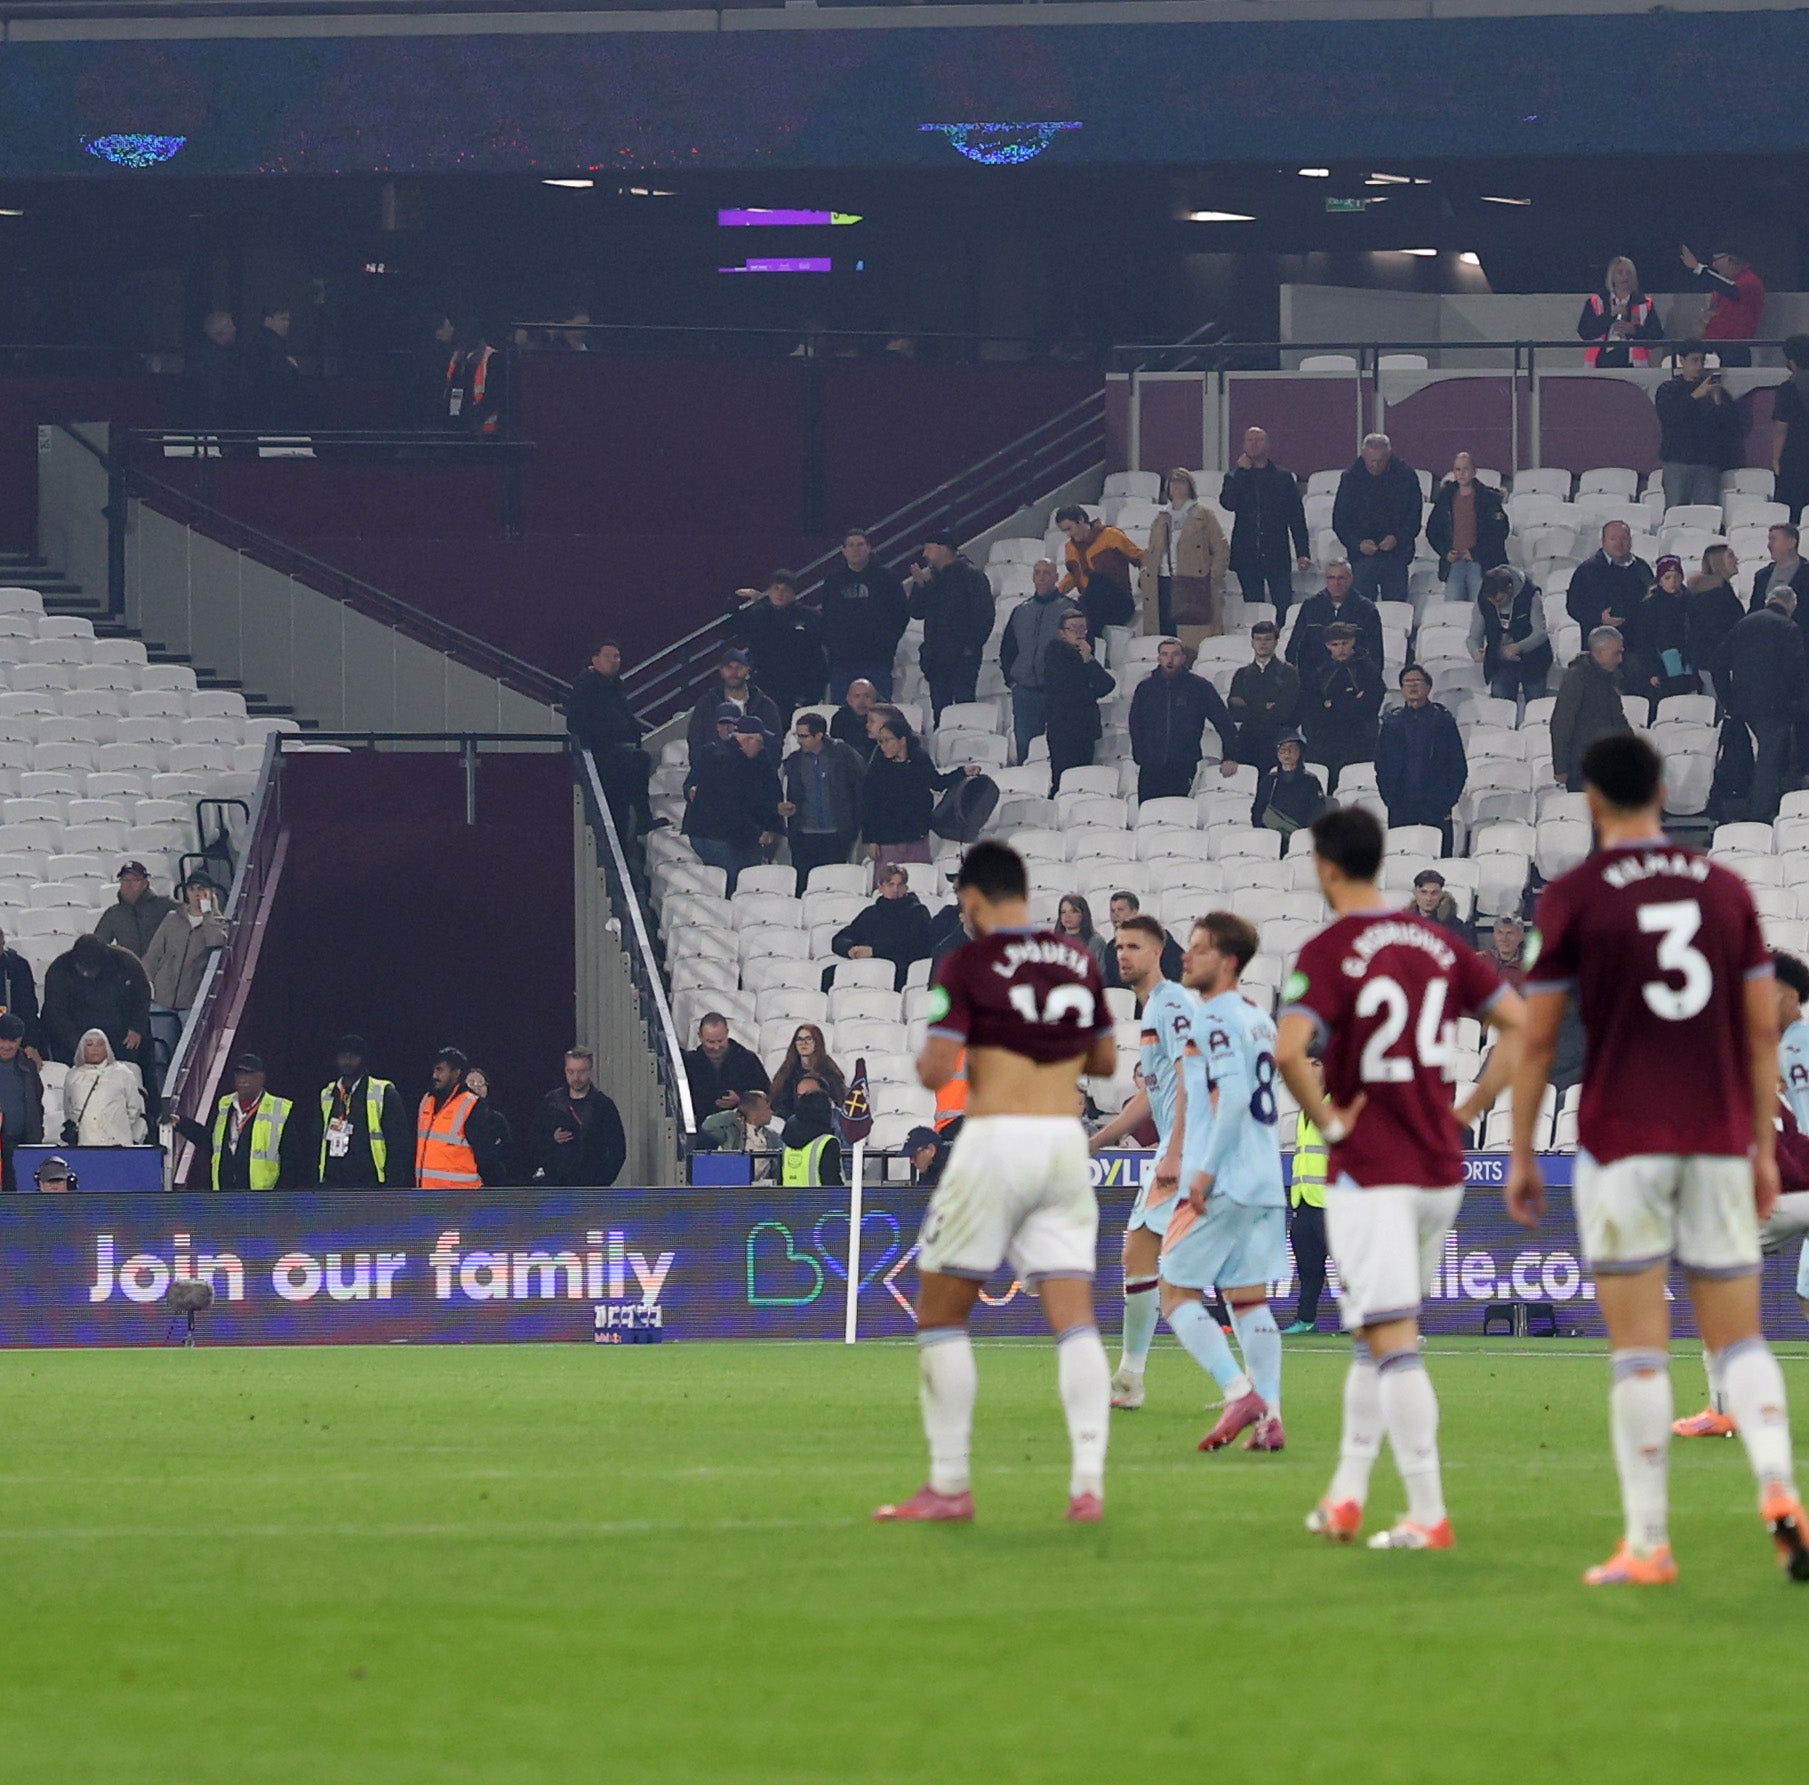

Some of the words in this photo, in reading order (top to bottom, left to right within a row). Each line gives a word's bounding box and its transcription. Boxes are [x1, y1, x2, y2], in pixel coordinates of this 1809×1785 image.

[1636, 899, 1713, 1021] 3
[1355, 975, 1457, 1083] 24
[1250, 1051, 1279, 1125] 8
[1088, 1159, 1151, 1187] OYL
[1461, 1161, 1503, 1181] ORTS
[89, 1234, 244, 1303] Join
[272, 1252, 406, 1301] our
[428, 1230, 676, 1311] family
